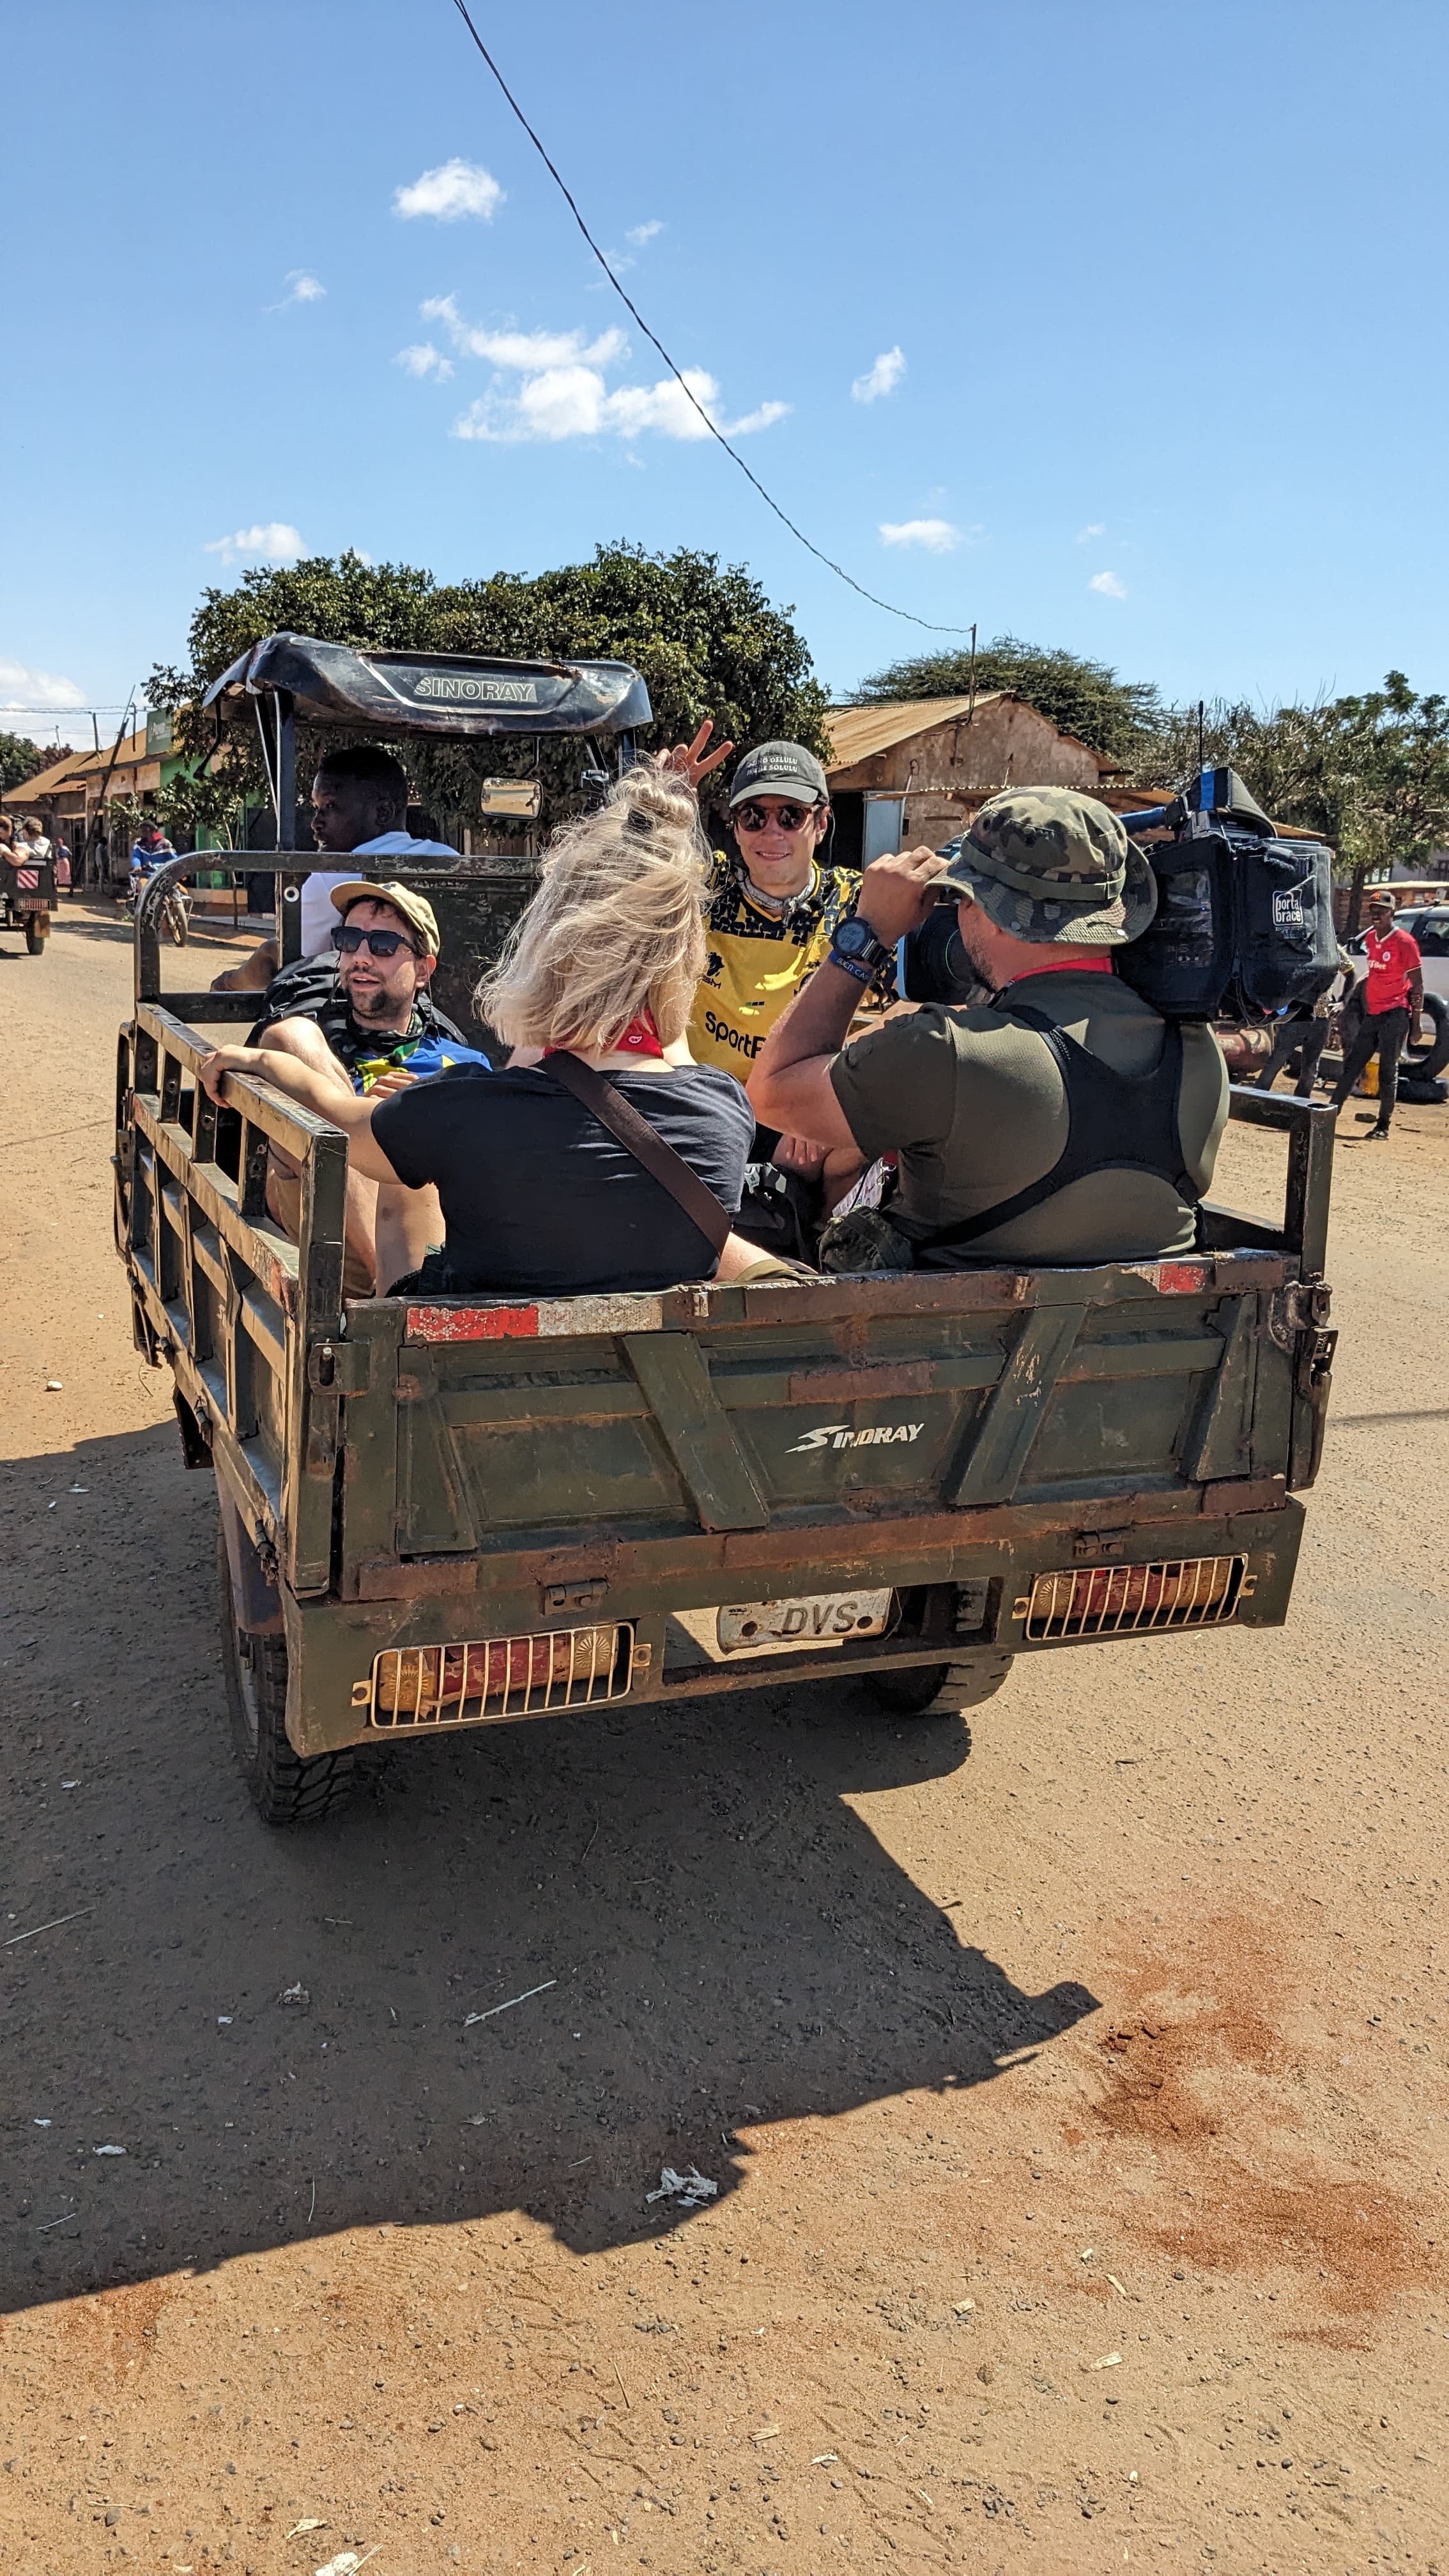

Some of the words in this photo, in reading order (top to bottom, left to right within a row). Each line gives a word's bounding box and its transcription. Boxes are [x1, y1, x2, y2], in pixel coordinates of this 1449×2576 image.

[415, 677, 533, 701] SINORAY
[1275, 895, 1300, 911] porta
[1275, 909, 1301, 923] brace
[836, 958, 854, 971] BUEN
[784, 1423, 925, 1453] SINORAY
[781, 1600, 858, 1635] DVS
